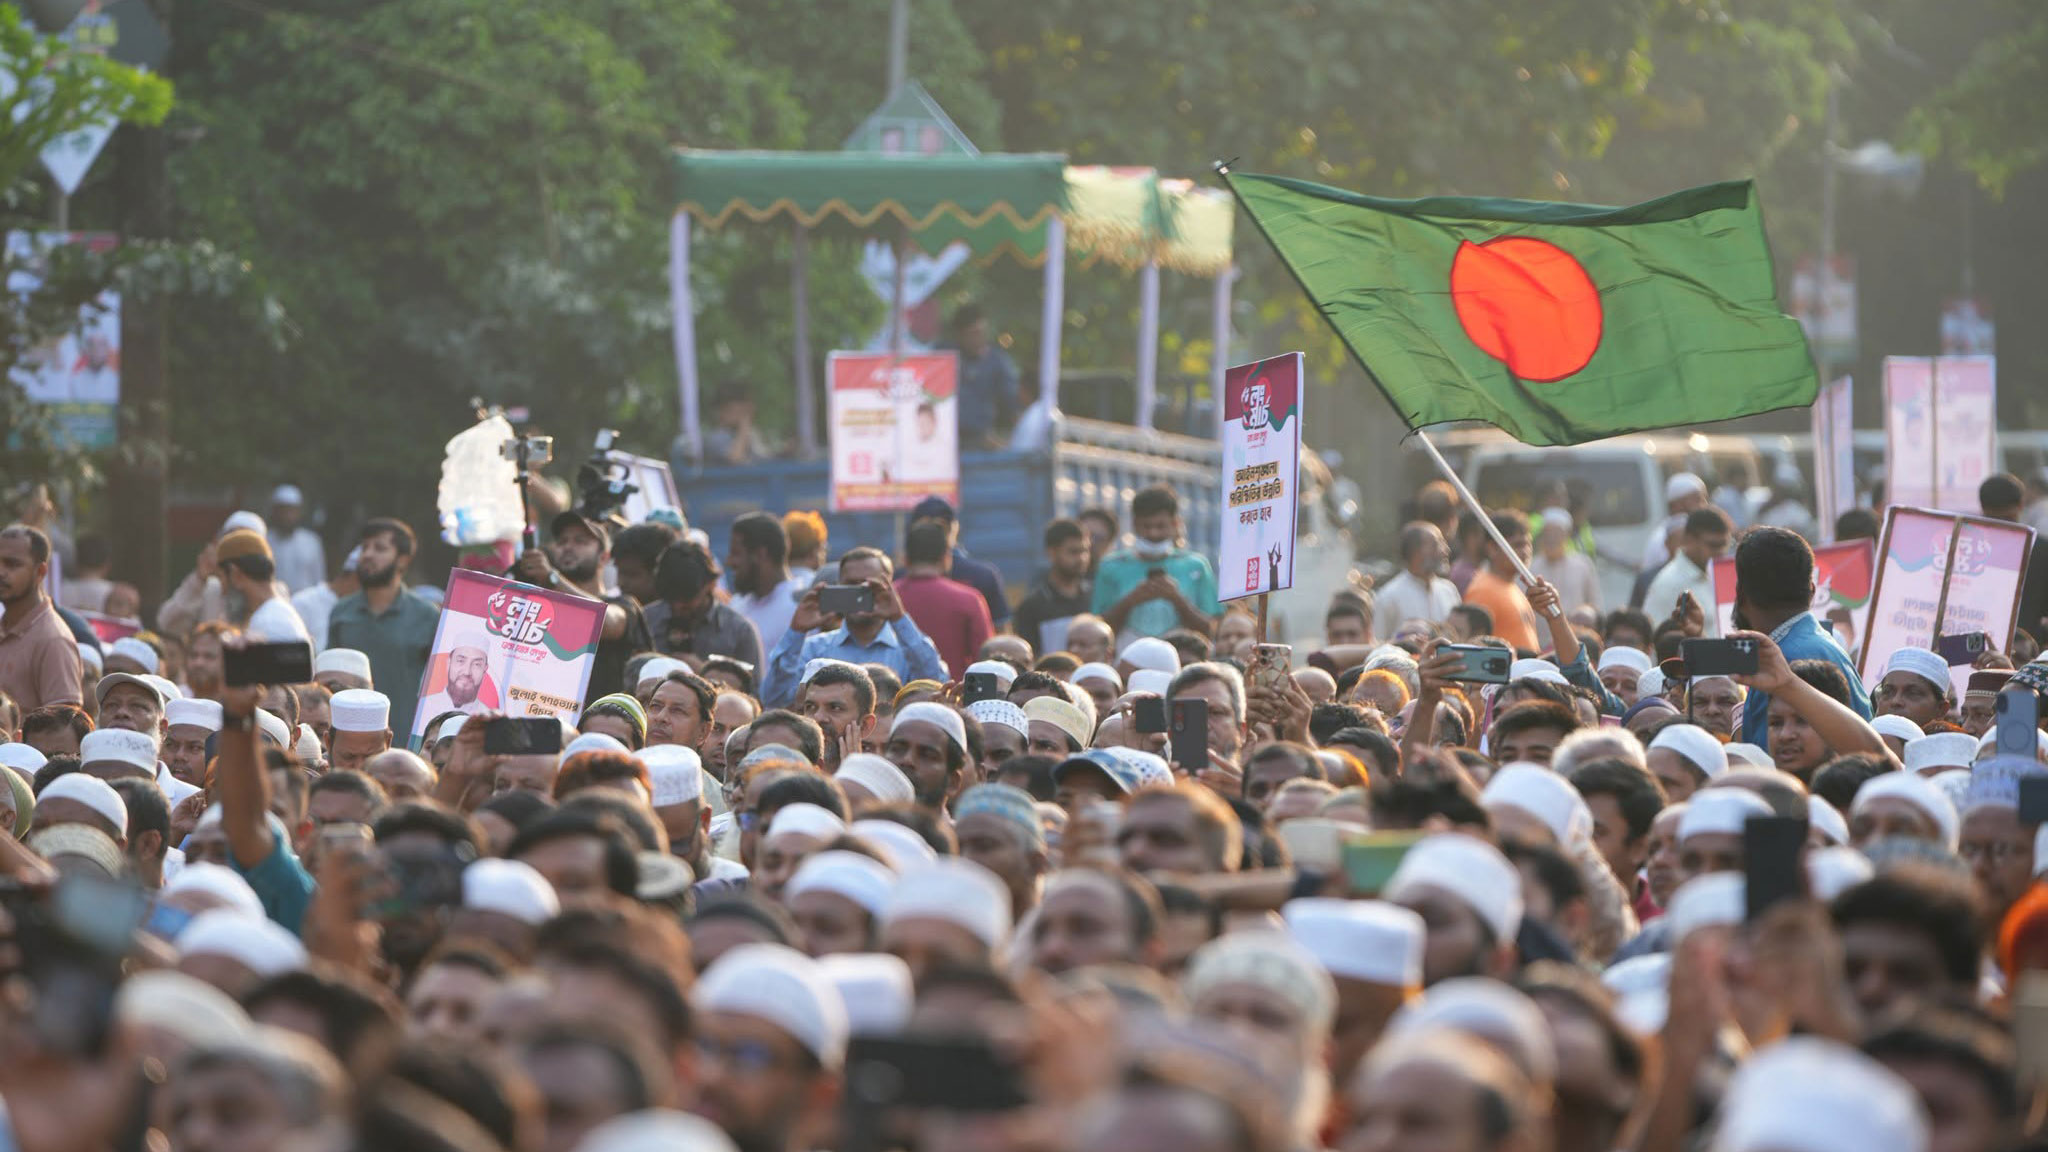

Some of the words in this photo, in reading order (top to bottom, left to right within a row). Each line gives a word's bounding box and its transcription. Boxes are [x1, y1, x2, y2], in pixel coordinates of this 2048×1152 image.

[1249, 395, 1271, 427] মার্চ
[1259, 505, 1272, 522] হবে
[507, 596, 542, 622] লং
[501, 617, 551, 644] মার্চ
[511, 687, 537, 701] জুলাই
